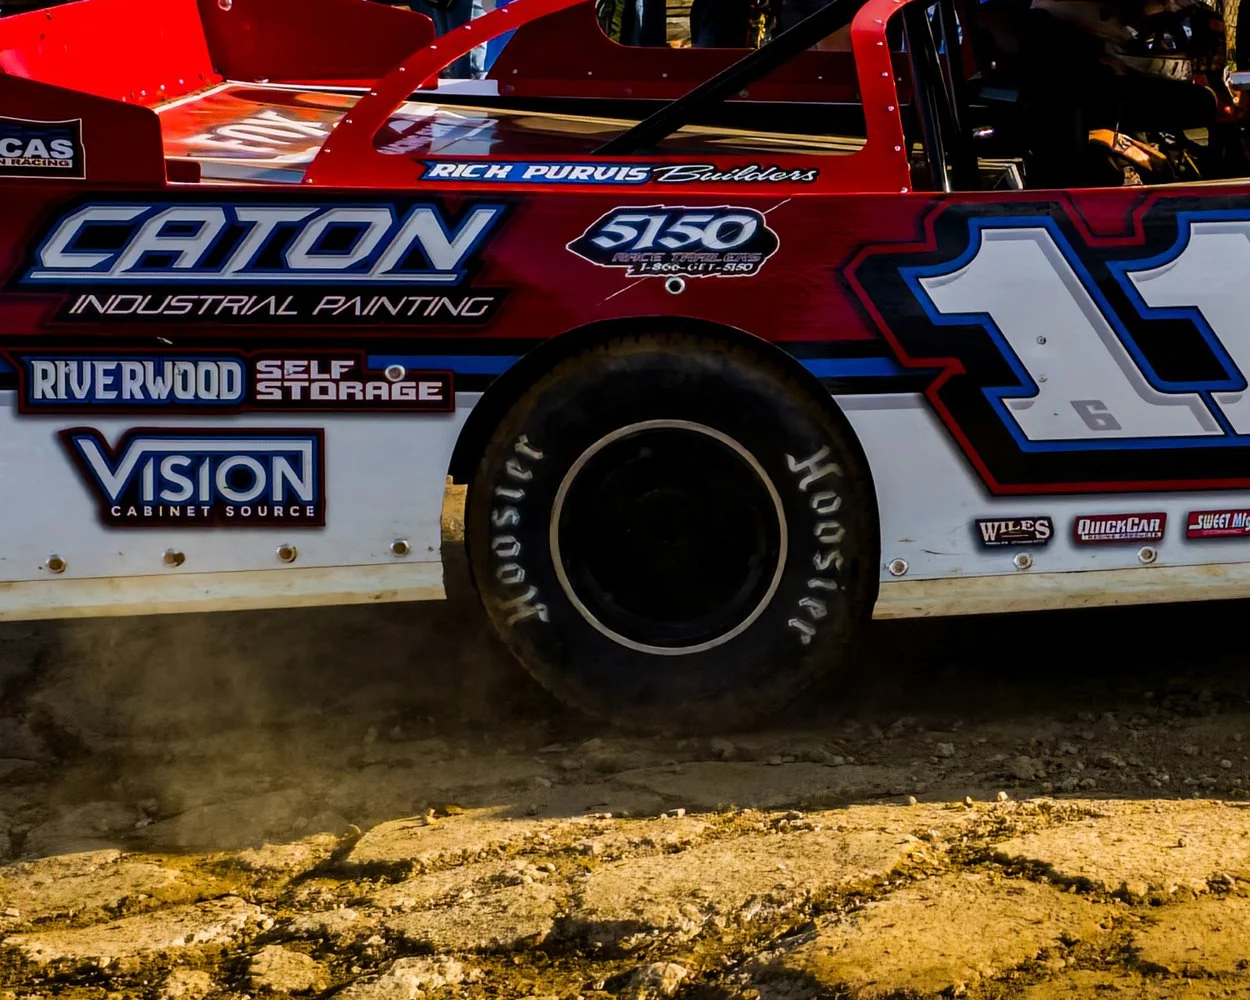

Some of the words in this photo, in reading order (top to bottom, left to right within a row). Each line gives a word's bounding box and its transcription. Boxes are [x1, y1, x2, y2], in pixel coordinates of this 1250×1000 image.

[11, 159, 70, 167] RACING
[428, 162, 511, 179] RICK
[522, 164, 652, 182] PURVIS
[653, 164, 817, 184] Builders
[38, 205, 498, 272] CATON
[591, 214, 758, 250] 5150
[68, 293, 299, 317] INDUSTRIAL
[311, 293, 495, 318] PAINTING
[30, 360, 242, 401] RIVERWOOD
[256, 359, 356, 380] SELF
[255, 381, 444, 401] STORAGE
[1070, 400, 1122, 431] 6
[77, 438, 314, 502] VISION
[110, 505, 212, 518] CABINET
[225, 505, 317, 518] SOURCE
[1194, 512, 1231, 530] SWEET
[979, 519, 1050, 542] WILES
[784, 443, 848, 647] Hoosier
